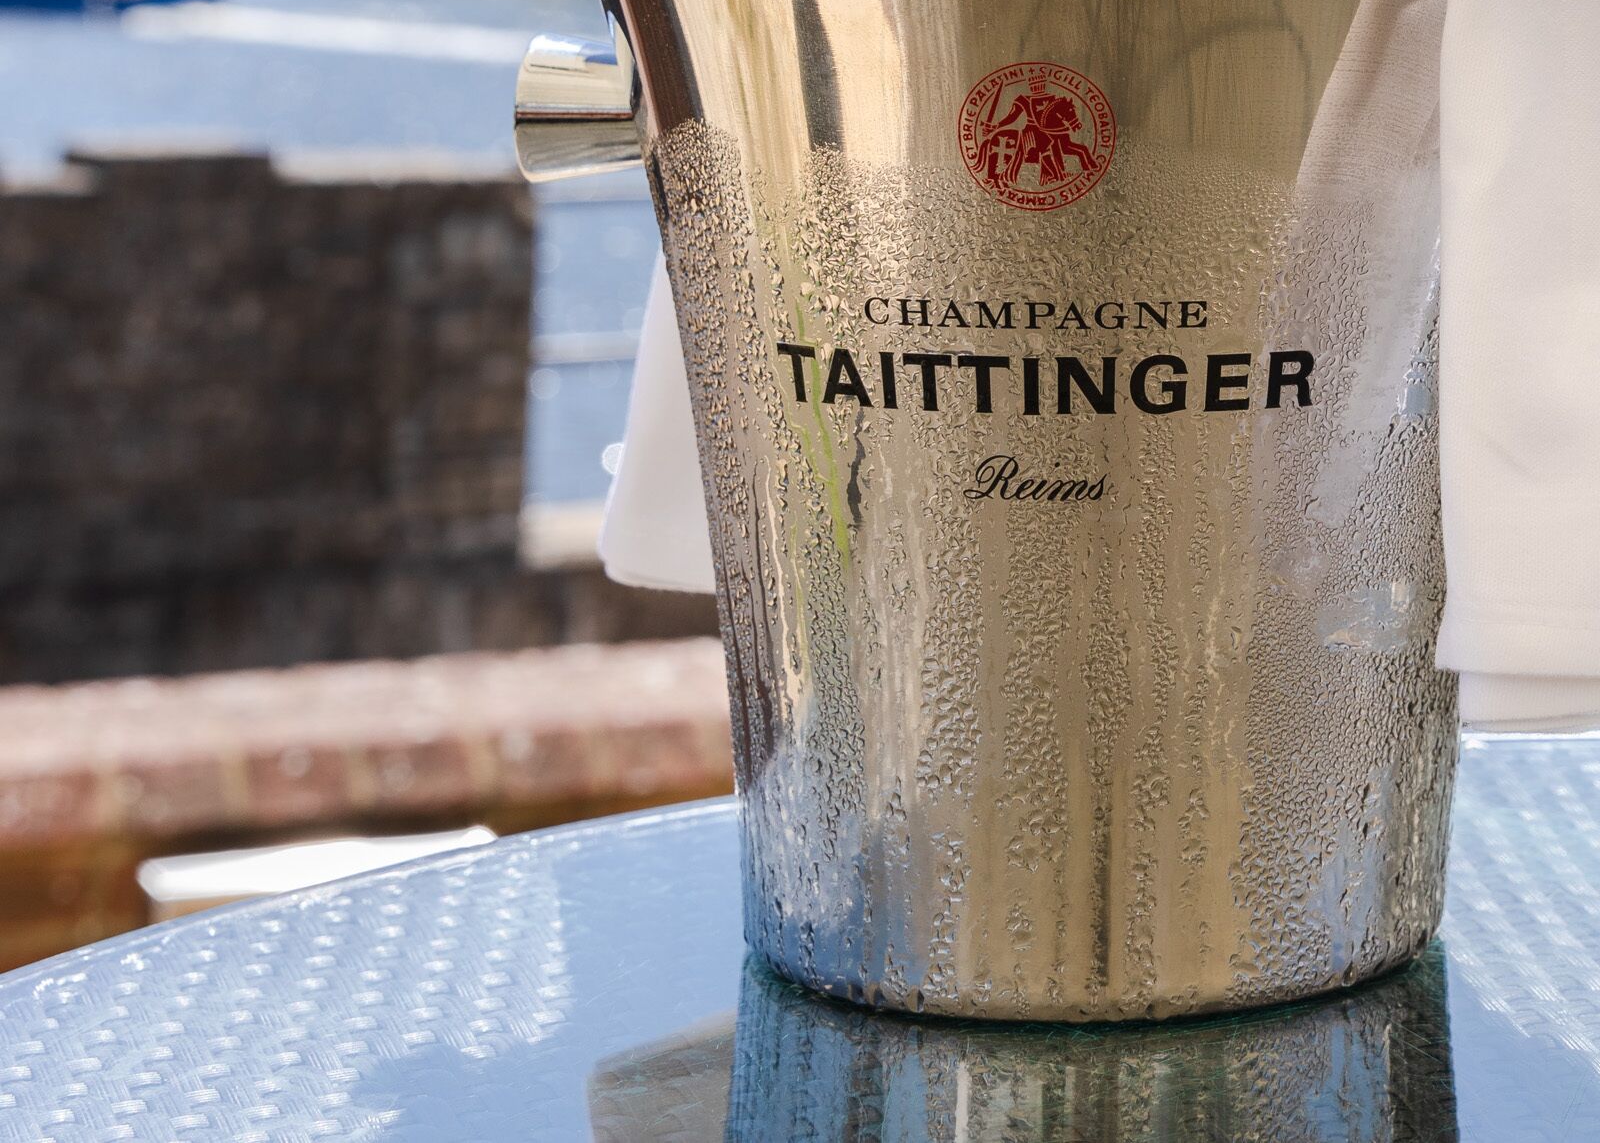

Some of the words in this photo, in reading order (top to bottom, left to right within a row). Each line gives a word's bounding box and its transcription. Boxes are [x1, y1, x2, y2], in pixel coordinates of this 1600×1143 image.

[863, 297, 1209, 330] CHAMPAGNE
[776, 342, 1316, 416] TAITTINGER
[962, 454, 1110, 501] Reims
